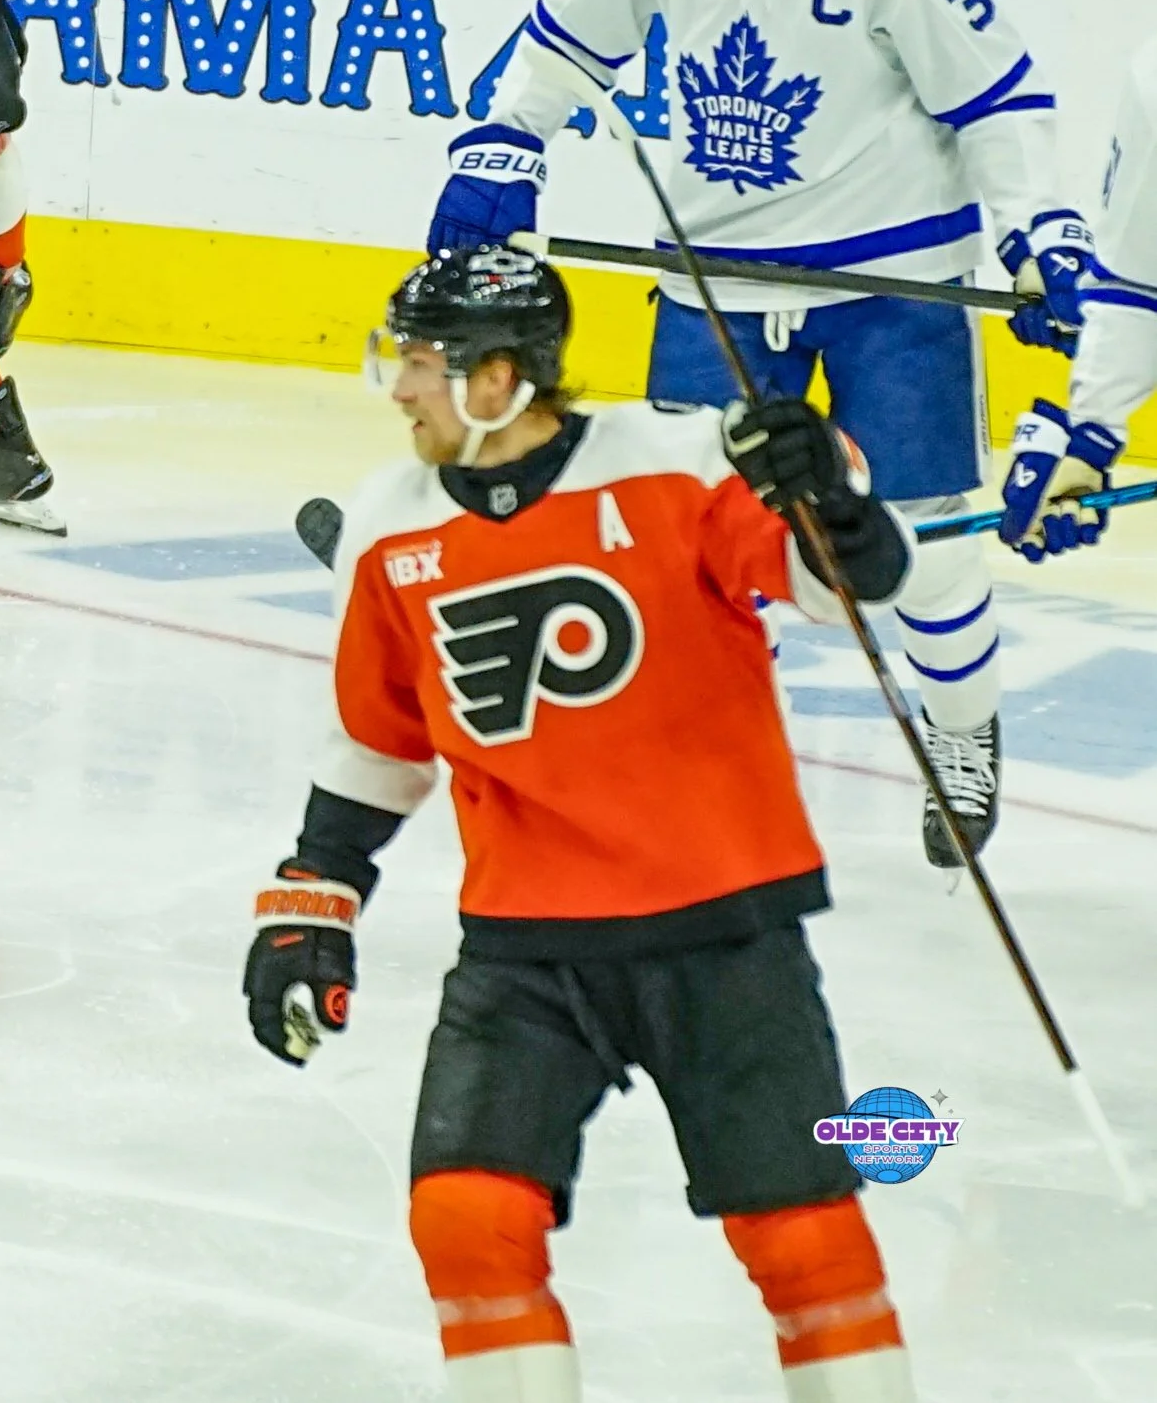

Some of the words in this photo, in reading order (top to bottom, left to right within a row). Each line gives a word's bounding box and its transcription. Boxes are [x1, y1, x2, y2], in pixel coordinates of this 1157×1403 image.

[692, 94, 792, 133] TORONTO
[705, 117, 774, 146] MAPLE
[704, 137, 774, 165] LEAFS
[459, 152, 547, 181] BAUE
[597, 488, 635, 553] A
